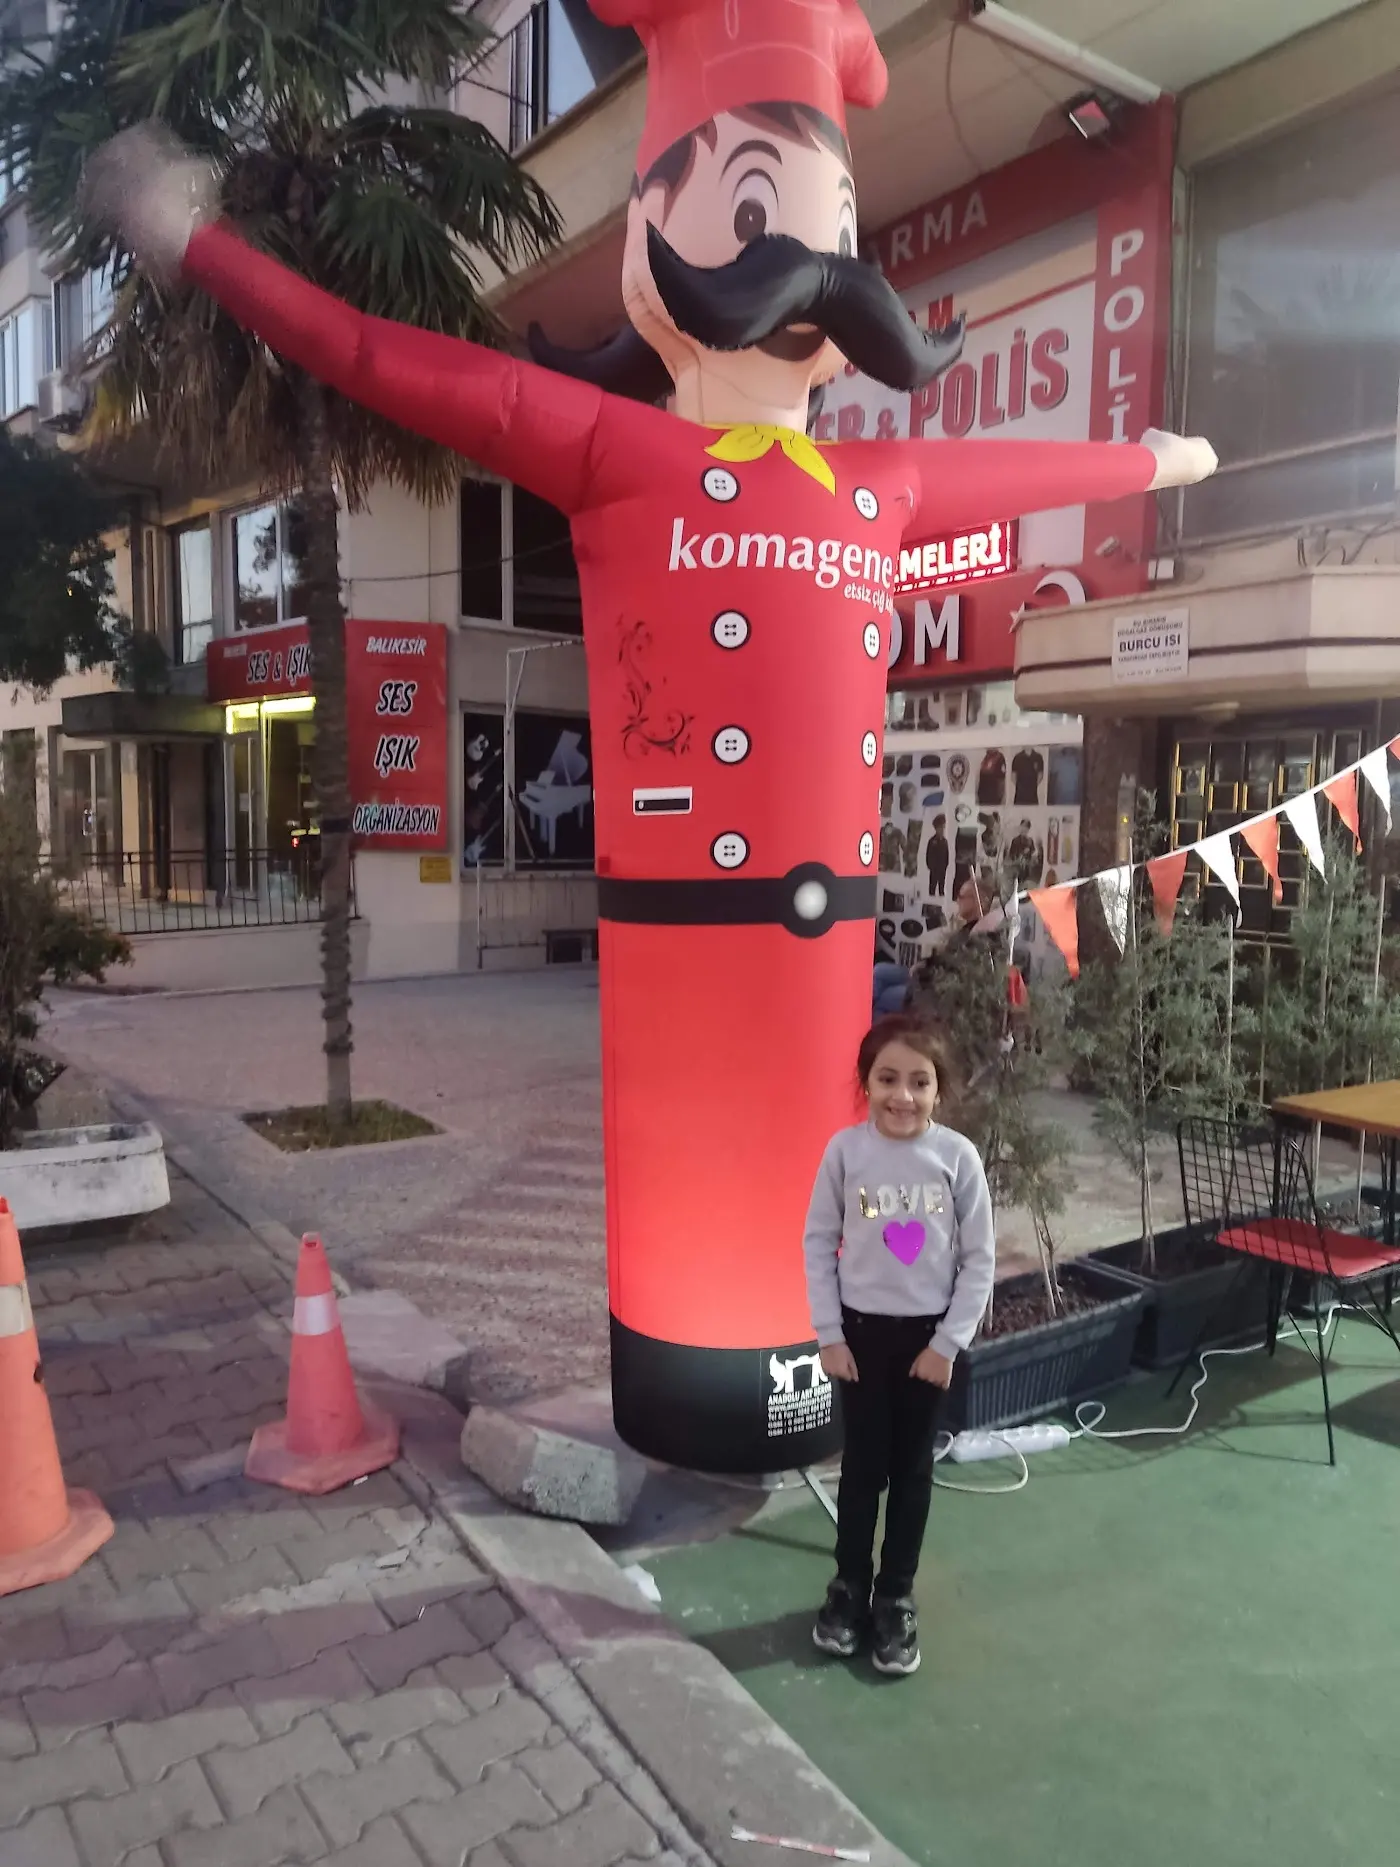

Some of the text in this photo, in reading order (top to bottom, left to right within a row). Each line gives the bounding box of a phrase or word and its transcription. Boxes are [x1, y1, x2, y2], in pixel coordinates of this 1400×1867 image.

[908, 326, 1069, 439] POLİS
[668, 516, 894, 590] komagene
[894, 521, 1002, 584] MELERİ
[844, 581, 872, 604] etsiz
[366, 635, 428, 656] BALIKESİR
[1119, 633, 1181, 653] BURCU ISI
[246, 650, 272, 685] SES
[272, 651, 283, 683] &
[376, 679, 418, 716] SES
[373, 733, 421, 779] IŞIK
[352, 797, 441, 836] ORGANİZASYON
[859, 1184, 945, 1219] LOVE
